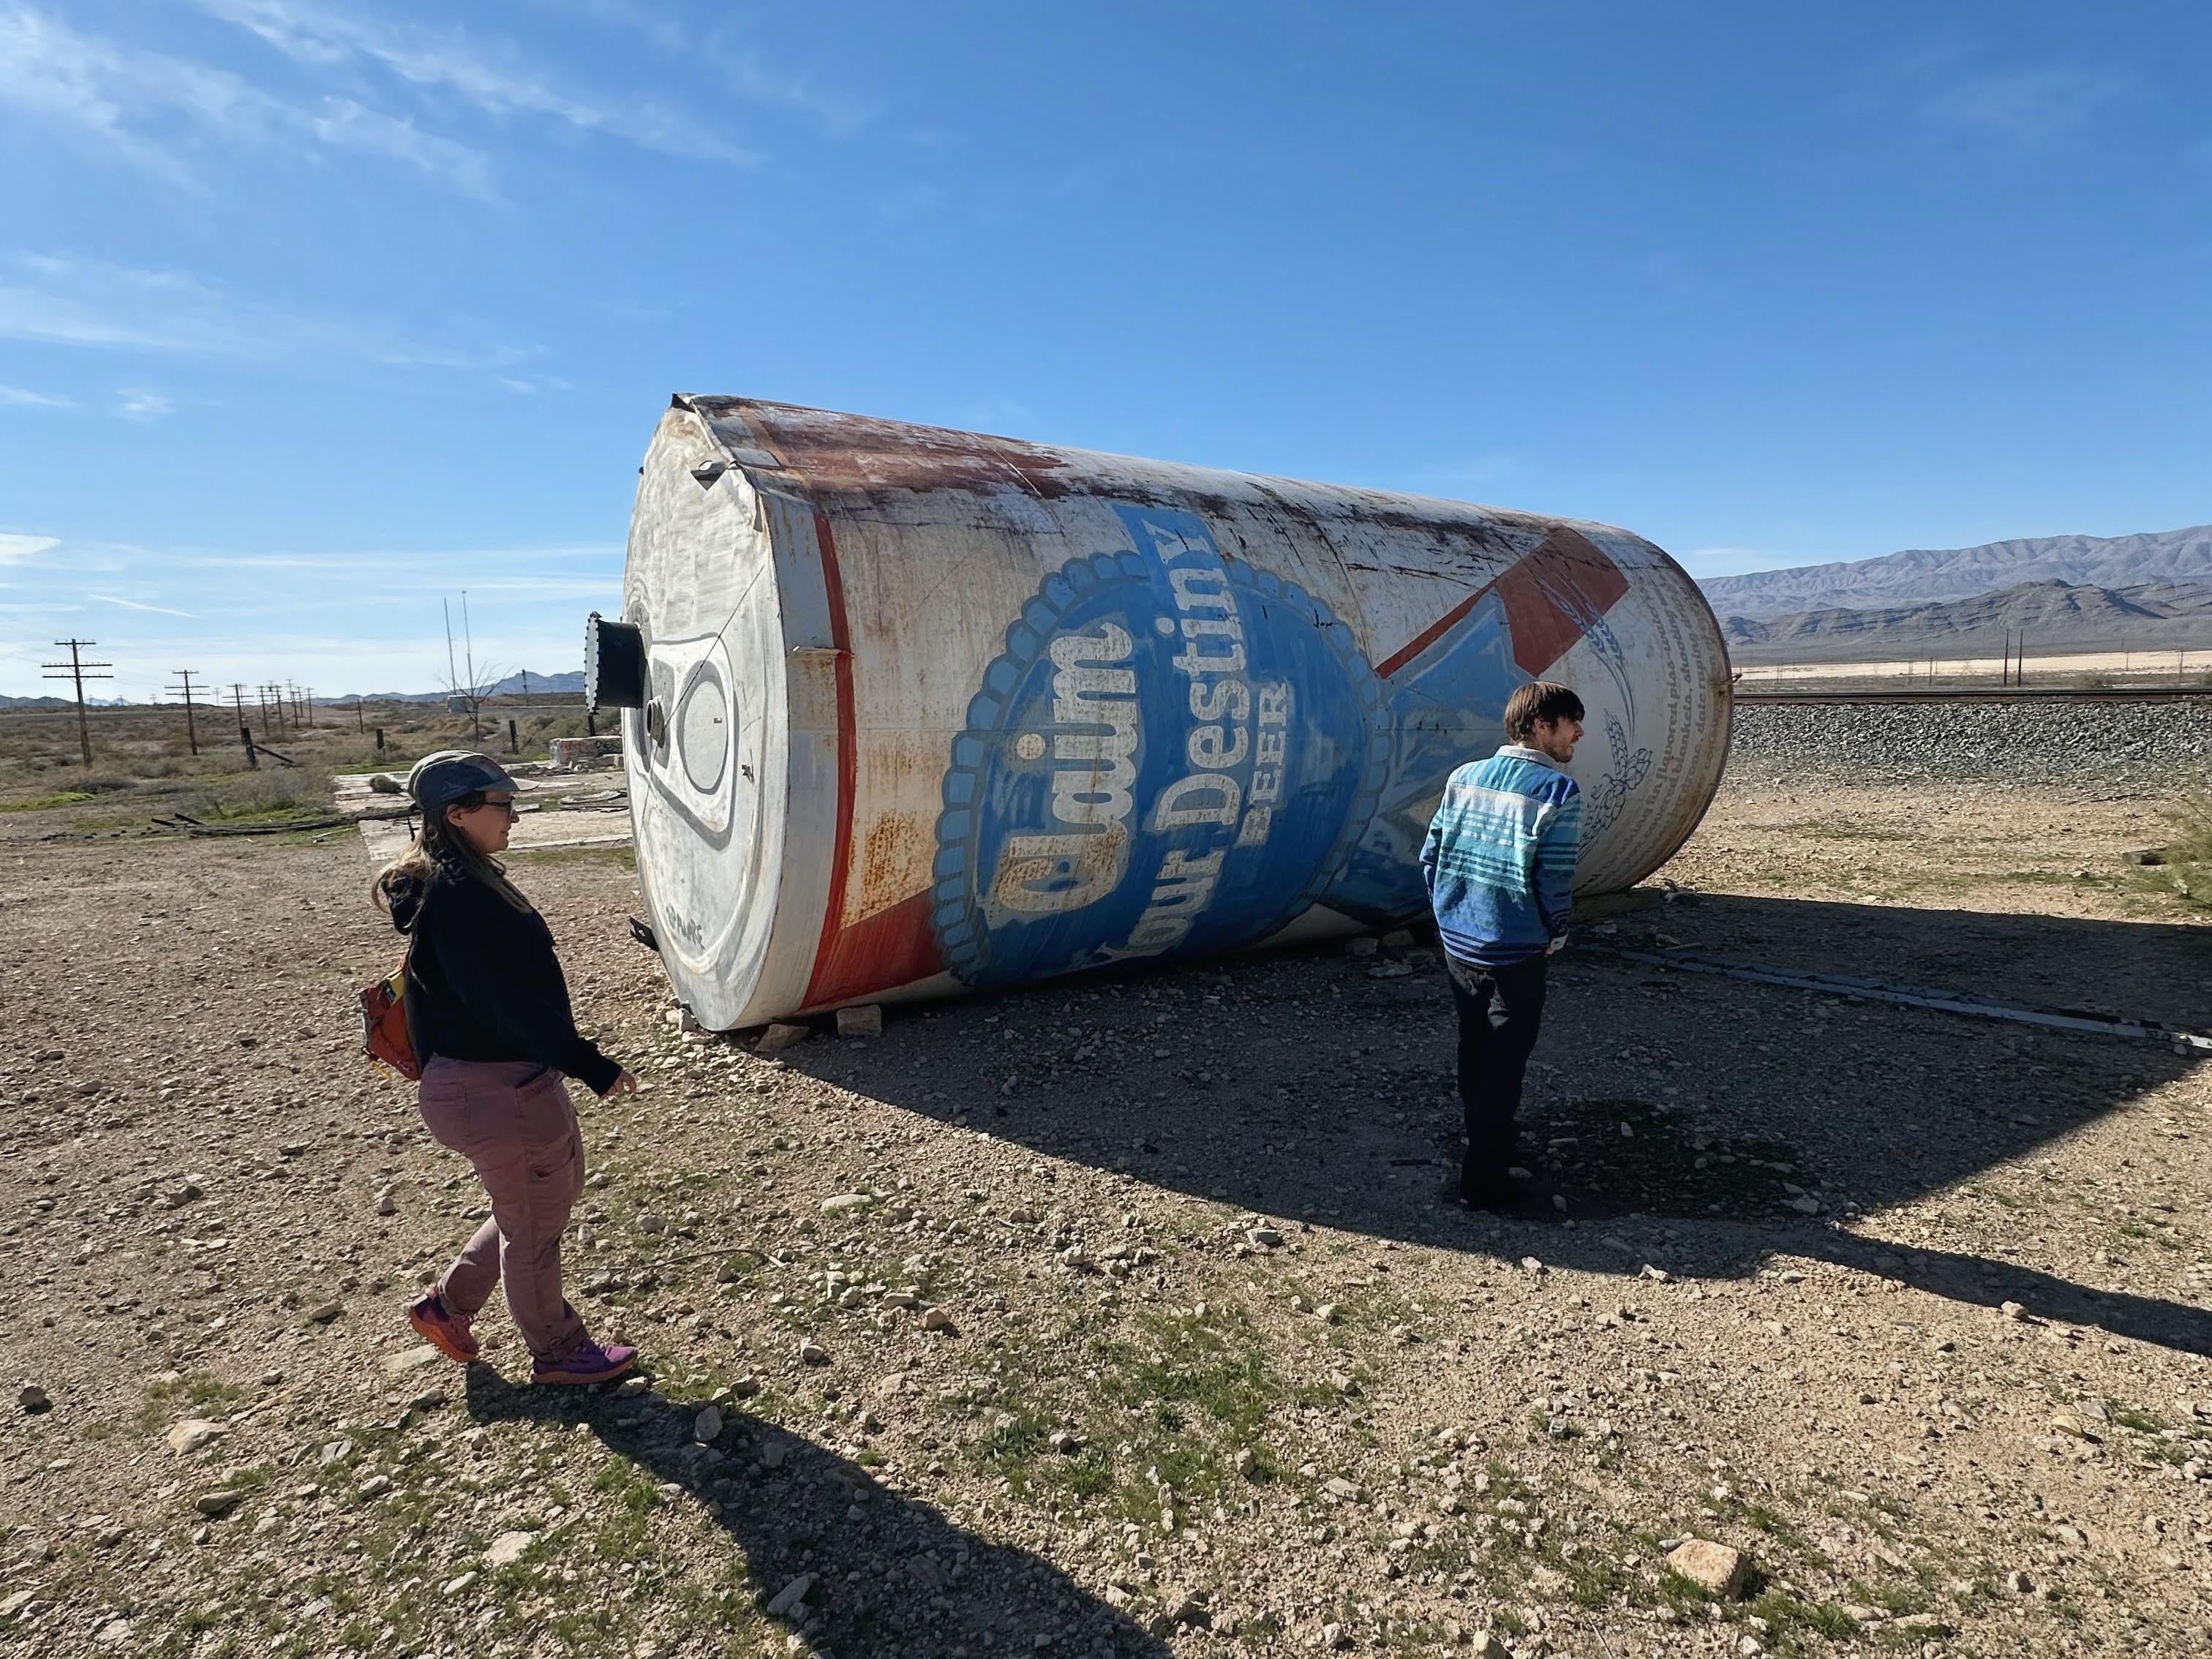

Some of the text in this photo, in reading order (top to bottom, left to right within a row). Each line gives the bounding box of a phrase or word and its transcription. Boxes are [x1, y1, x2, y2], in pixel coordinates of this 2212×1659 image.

[1689, 632, 1710, 690] raping
[1695, 692, 1706, 734] date
[996, 622, 1138, 913] Claim
[1236, 682, 1288, 846] BEER
[1644, 775, 1679, 838] covered
[1671, 688, 1693, 773] blankets,
[1655, 701, 1678, 783] flavored
